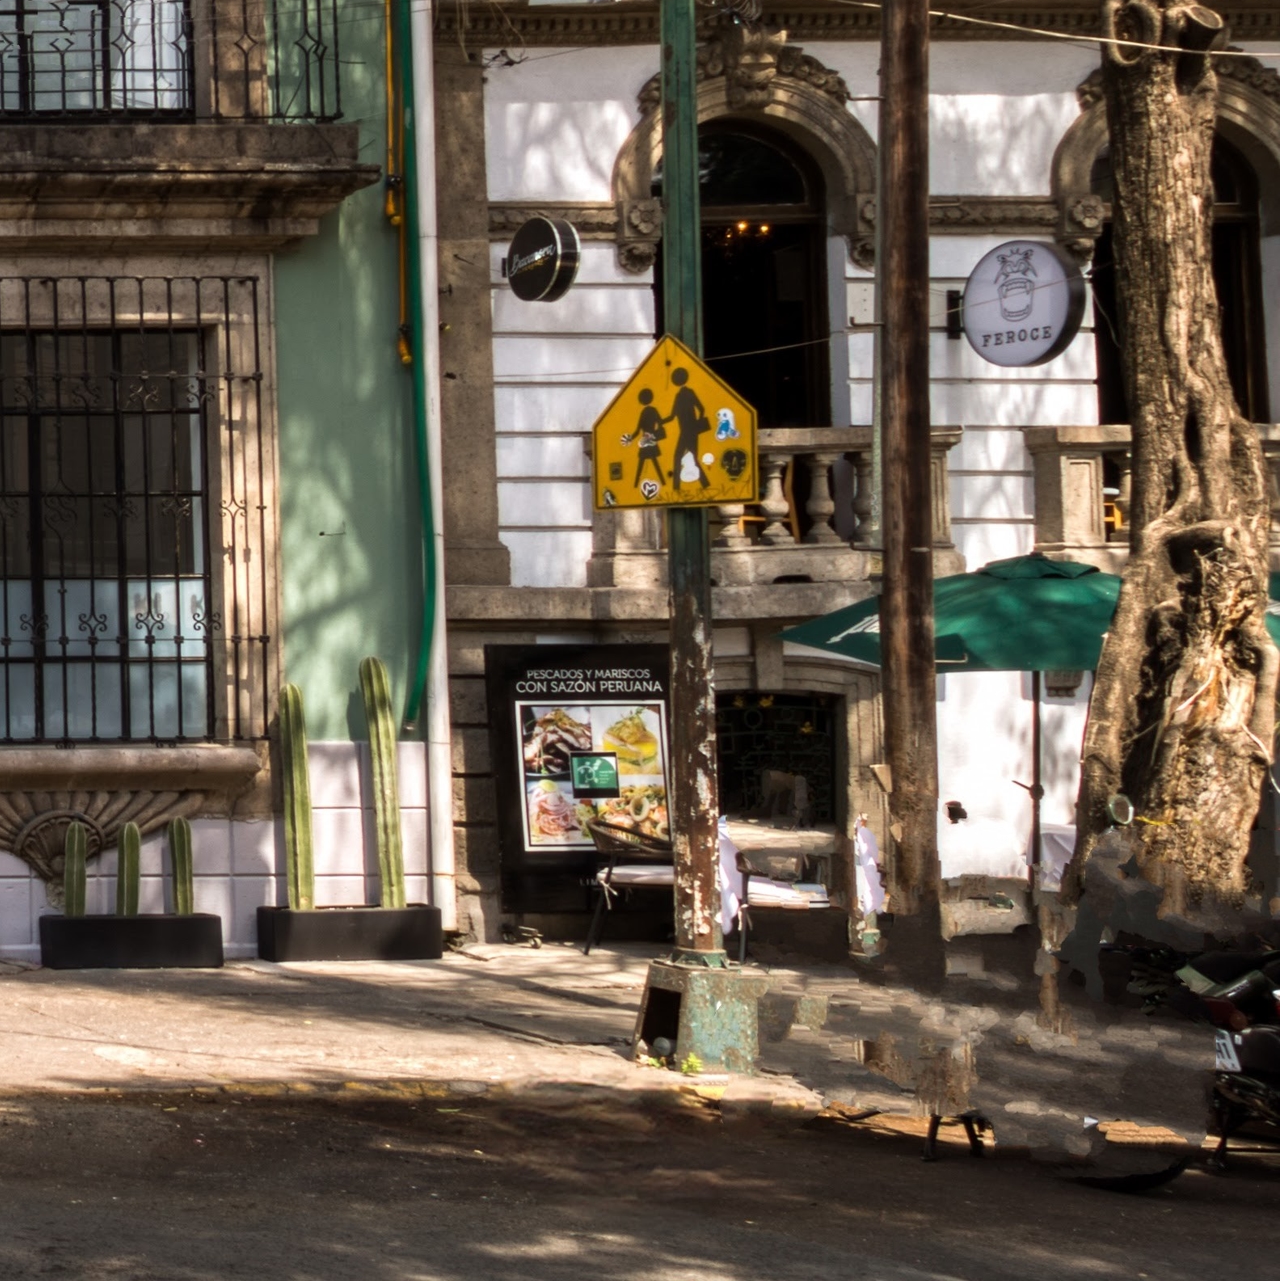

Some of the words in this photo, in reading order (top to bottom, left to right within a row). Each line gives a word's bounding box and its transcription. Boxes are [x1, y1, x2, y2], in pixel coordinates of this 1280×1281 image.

[981, 326, 1052, 348] FEROCE
[527, 669, 583, 679] PESCADOS
[585, 669, 591, 678] Y
[594, 669, 650, 679] MARISCOS
[516, 681, 547, 693] CON
[550, 678, 596, 693] SAZÓN
[600, 681, 663, 692] PERUANA
